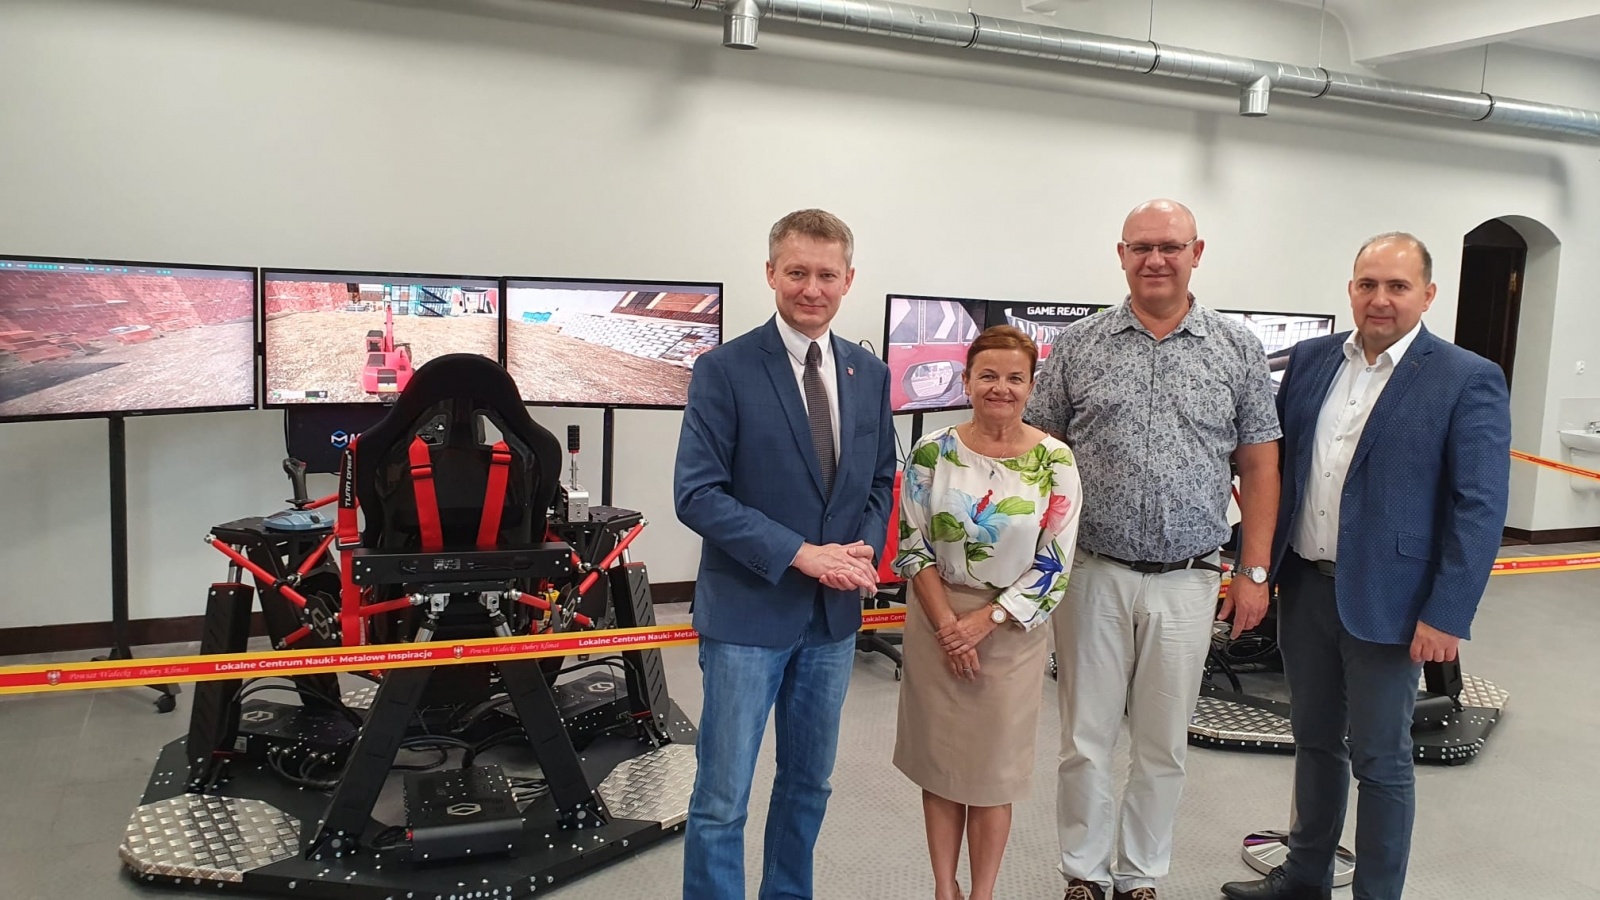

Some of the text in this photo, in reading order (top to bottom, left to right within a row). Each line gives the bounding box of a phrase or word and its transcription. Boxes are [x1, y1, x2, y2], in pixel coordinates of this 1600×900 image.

[1027, 306, 1056, 316] GAME
[1057, 307, 1090, 316] READY
[862, 614, 889, 623] Lokalne
[578, 637, 611, 647] Lokalne
[612, 635, 646, 644] Centrum
[215, 650, 433, 671] Lokalne Centrum Nauki- Metalowe Inspiracje
